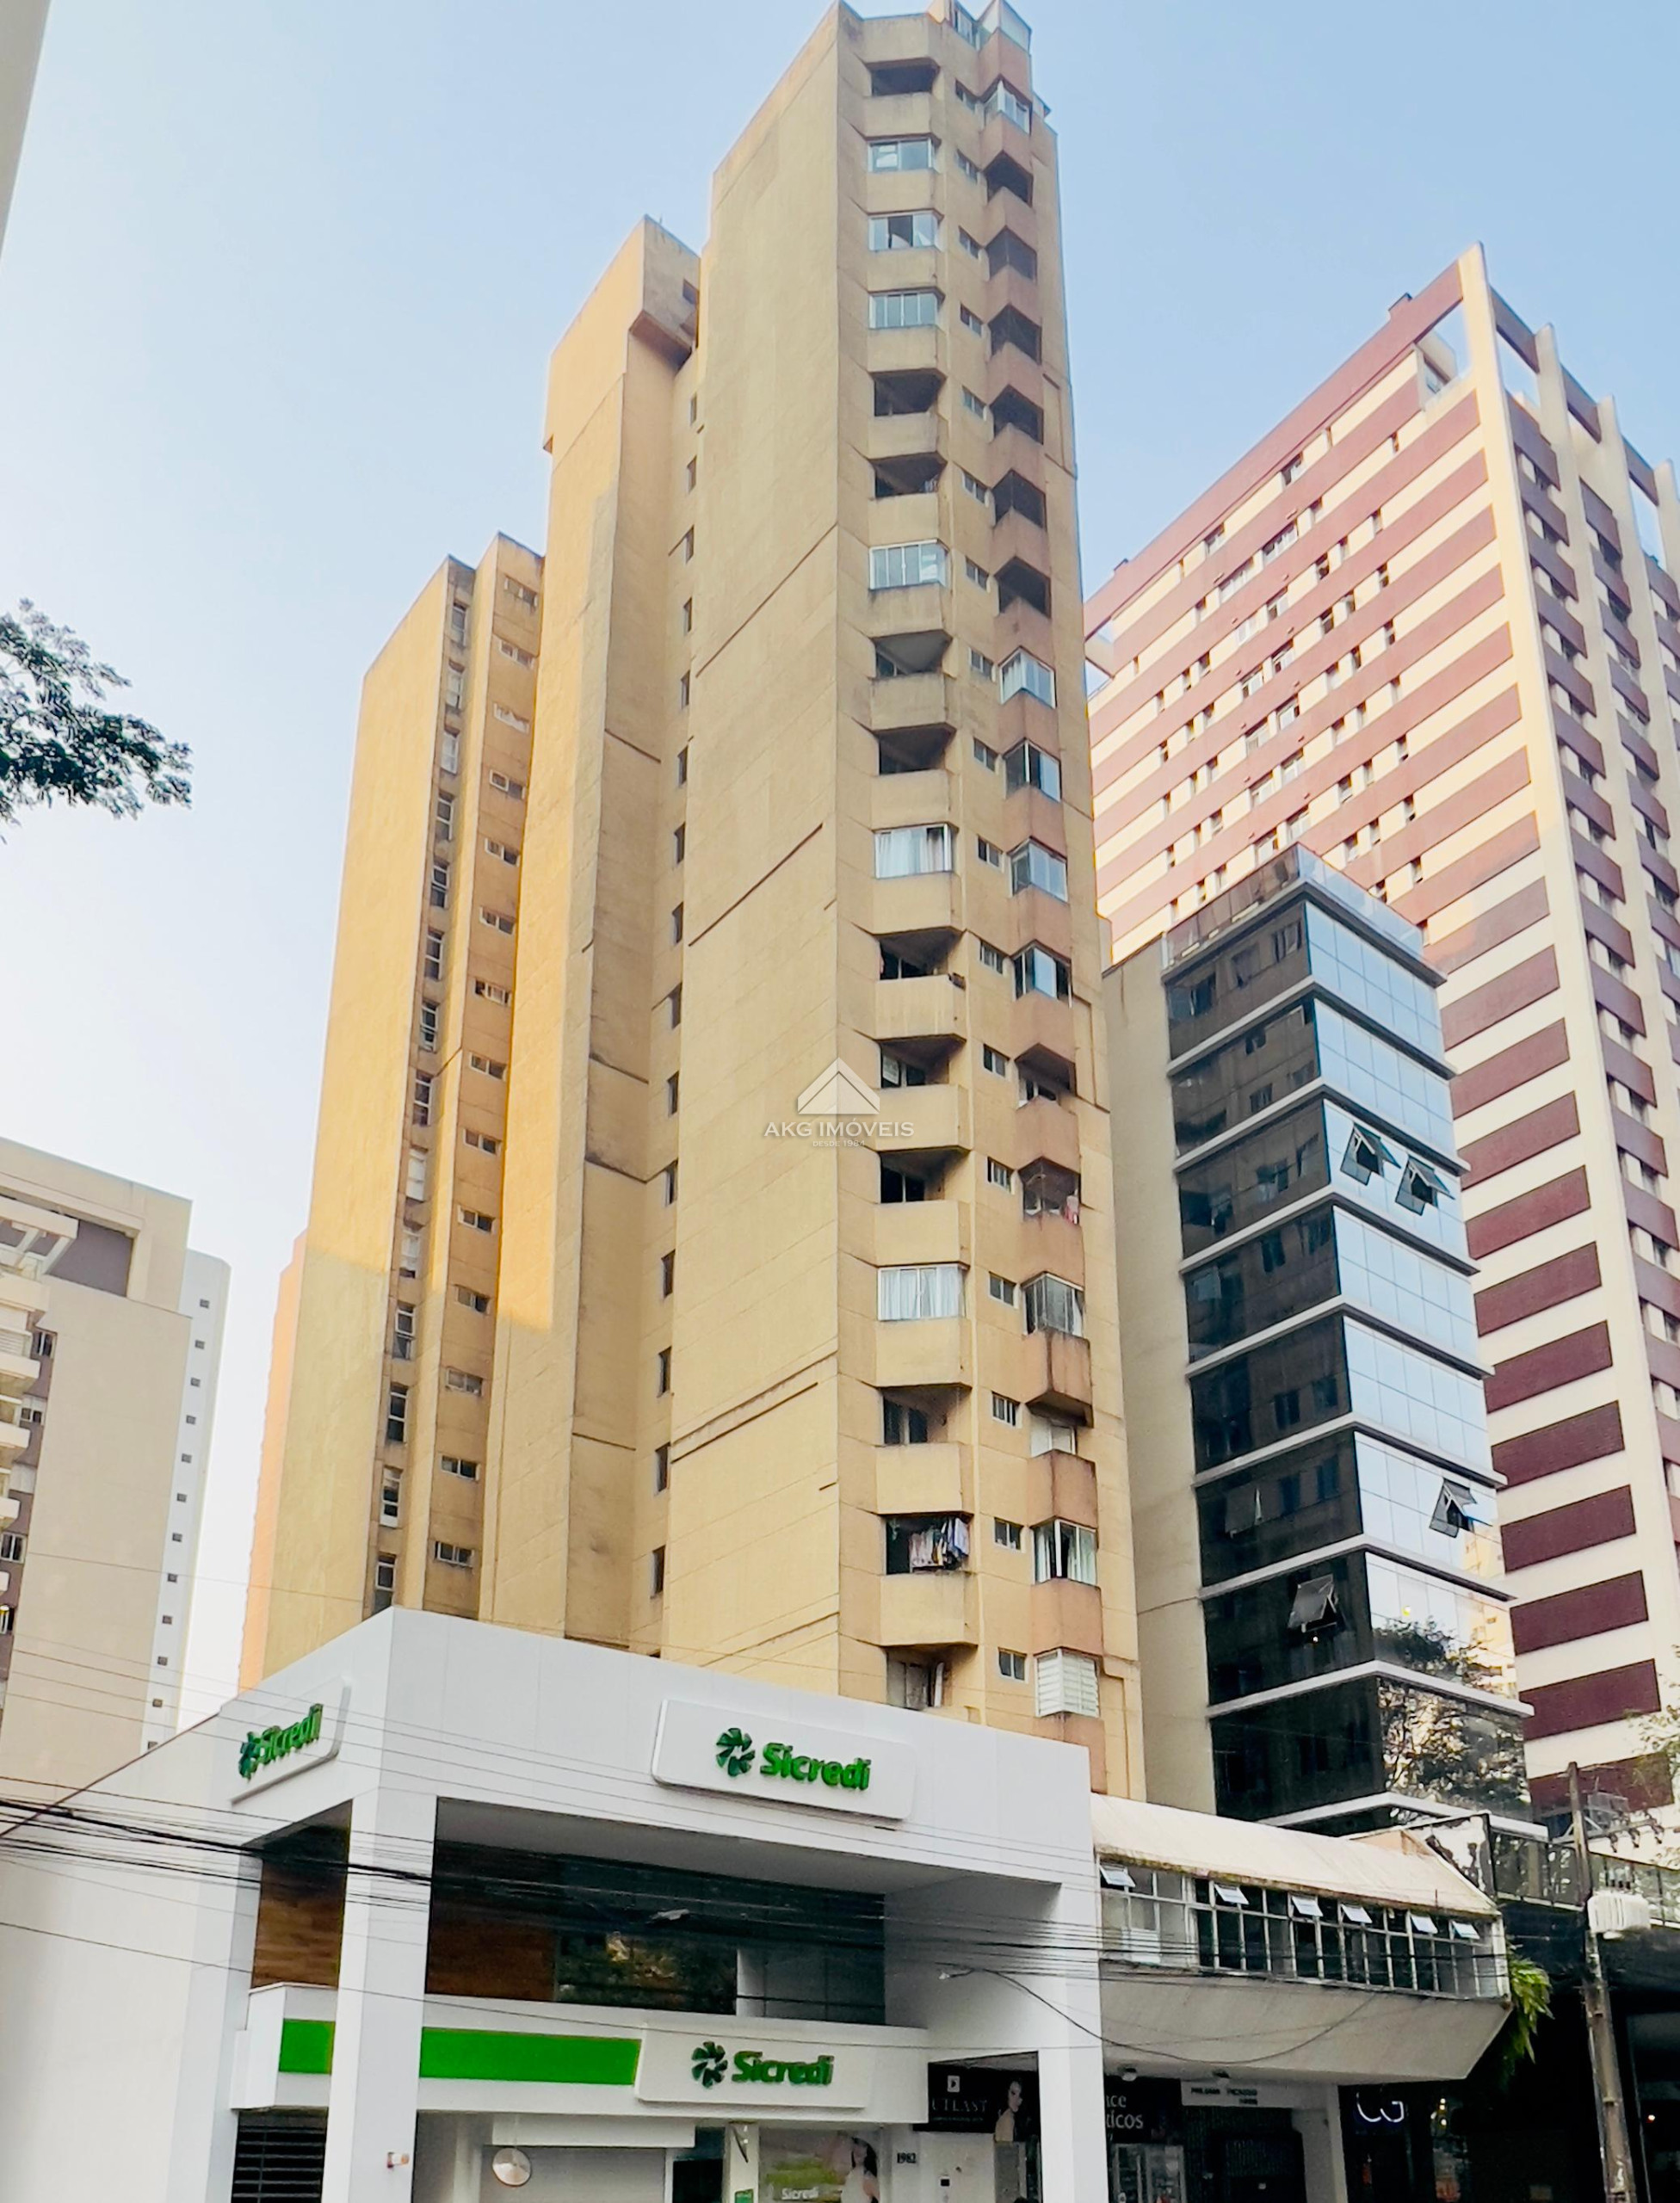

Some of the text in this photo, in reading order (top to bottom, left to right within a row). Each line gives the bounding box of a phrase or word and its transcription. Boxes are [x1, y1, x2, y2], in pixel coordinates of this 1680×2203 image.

[259, 1703, 324, 1765] Sicredi
[760, 1742, 872, 1791] Sicredi
[732, 2050, 835, 2085] Sicredi
